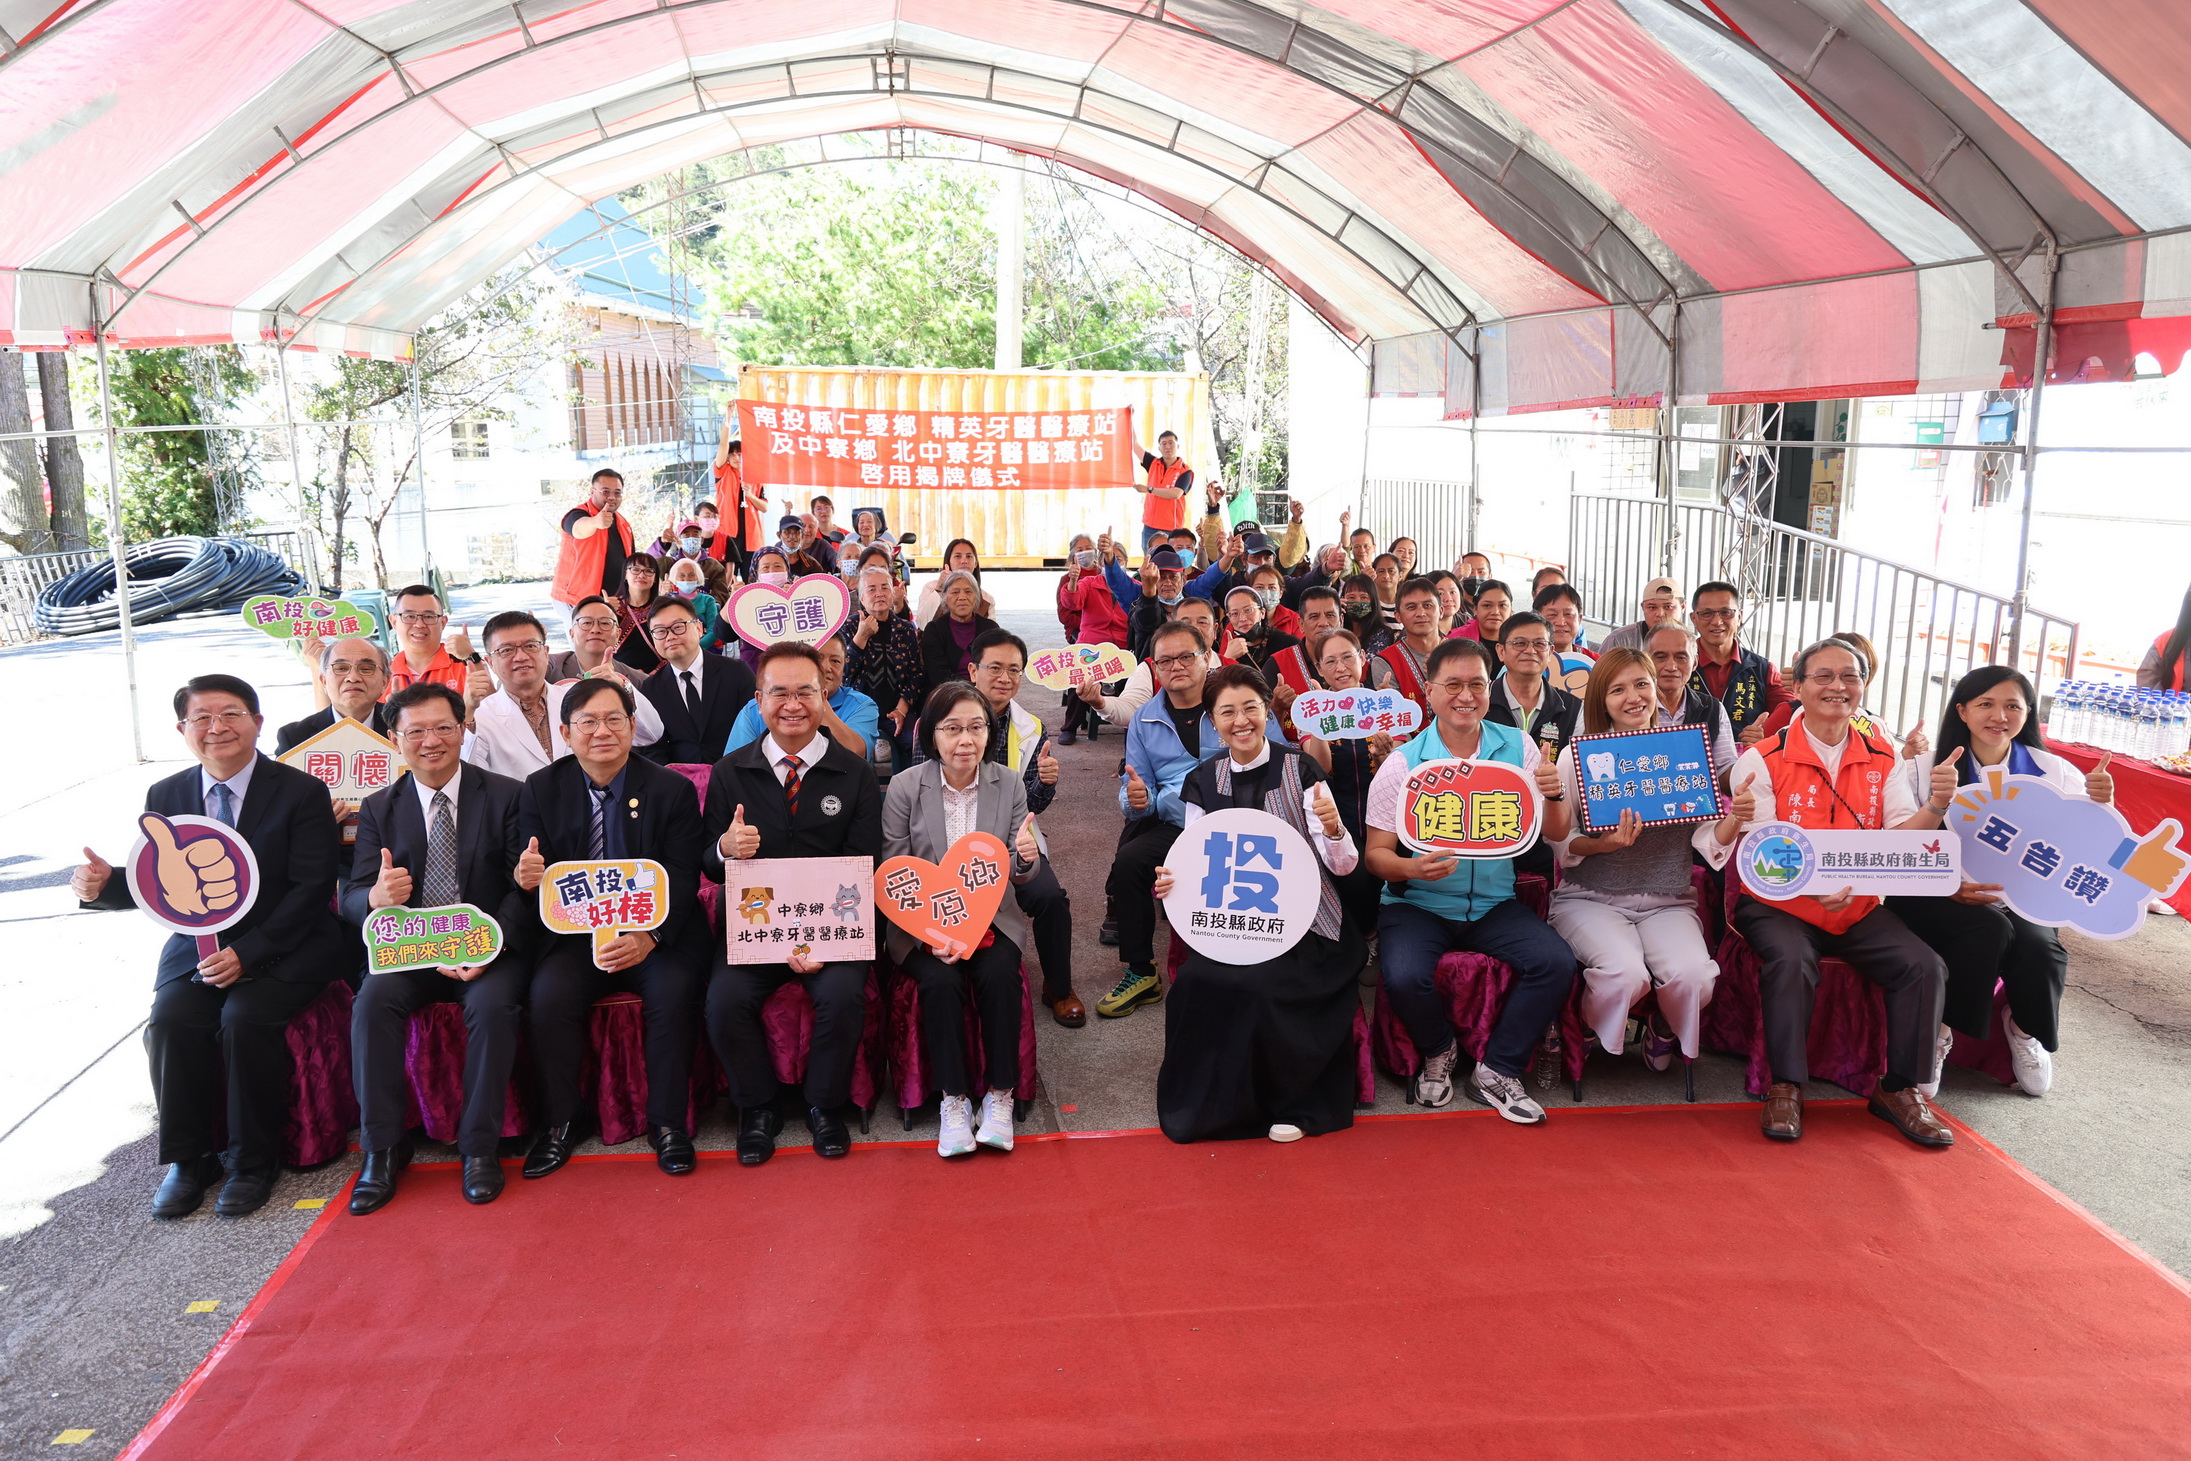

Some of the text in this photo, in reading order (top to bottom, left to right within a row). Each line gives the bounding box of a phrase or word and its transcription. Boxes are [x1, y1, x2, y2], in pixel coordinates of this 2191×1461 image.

[752, 406, 1117, 440] 南投縣仁愛鄉 精英牙醫醫療站
[770, 431, 1104, 464] 及中寮鄉 北中寮牙醫醫療站
[251, 600, 305, 625] 南投
[292, 615, 361, 637] 好健康
[757, 598, 827, 635] 守護
[1032, 651, 1076, 680] 南投
[1069, 656, 1125, 686] 最溫暖
[1300, 696, 1394, 718] 活力 快樂
[1732, 682, 1746, 721] 馬文君
[1748, 675, 1756, 710] 立法委員
[1319, 714, 1356, 735] 健康
[1375, 711, 1413, 731] 幸福
[306, 751, 389, 787] 關懷
[1618, 754, 1670, 774] 仁愛鄉
[1588, 773, 1709, 802] 精英牙醫醫療站
[1807, 784, 1817, 808] 局長
[1411, 790, 1522, 842] 健康
[1867, 784, 1879, 829] 南投縣政
[1201, 831, 1283, 914] 投
[1821, 852, 1950, 868] 南投縣政府衛生局
[1976, 815, 2111, 904] 五告讚
[555, 868, 623, 907] 南投
[586, 890, 654, 928] 好棒
[777, 902, 825, 918] 中寮鄉
[1191, 911, 1285, 935] 南投縣政府
[370, 912, 472, 945] 您的健康
[737, 925, 865, 943] 北中寮牙醫醫療站
[1190, 929, 1283, 943] Nantou County Government
[376, 925, 497, 967] 我們來守護
